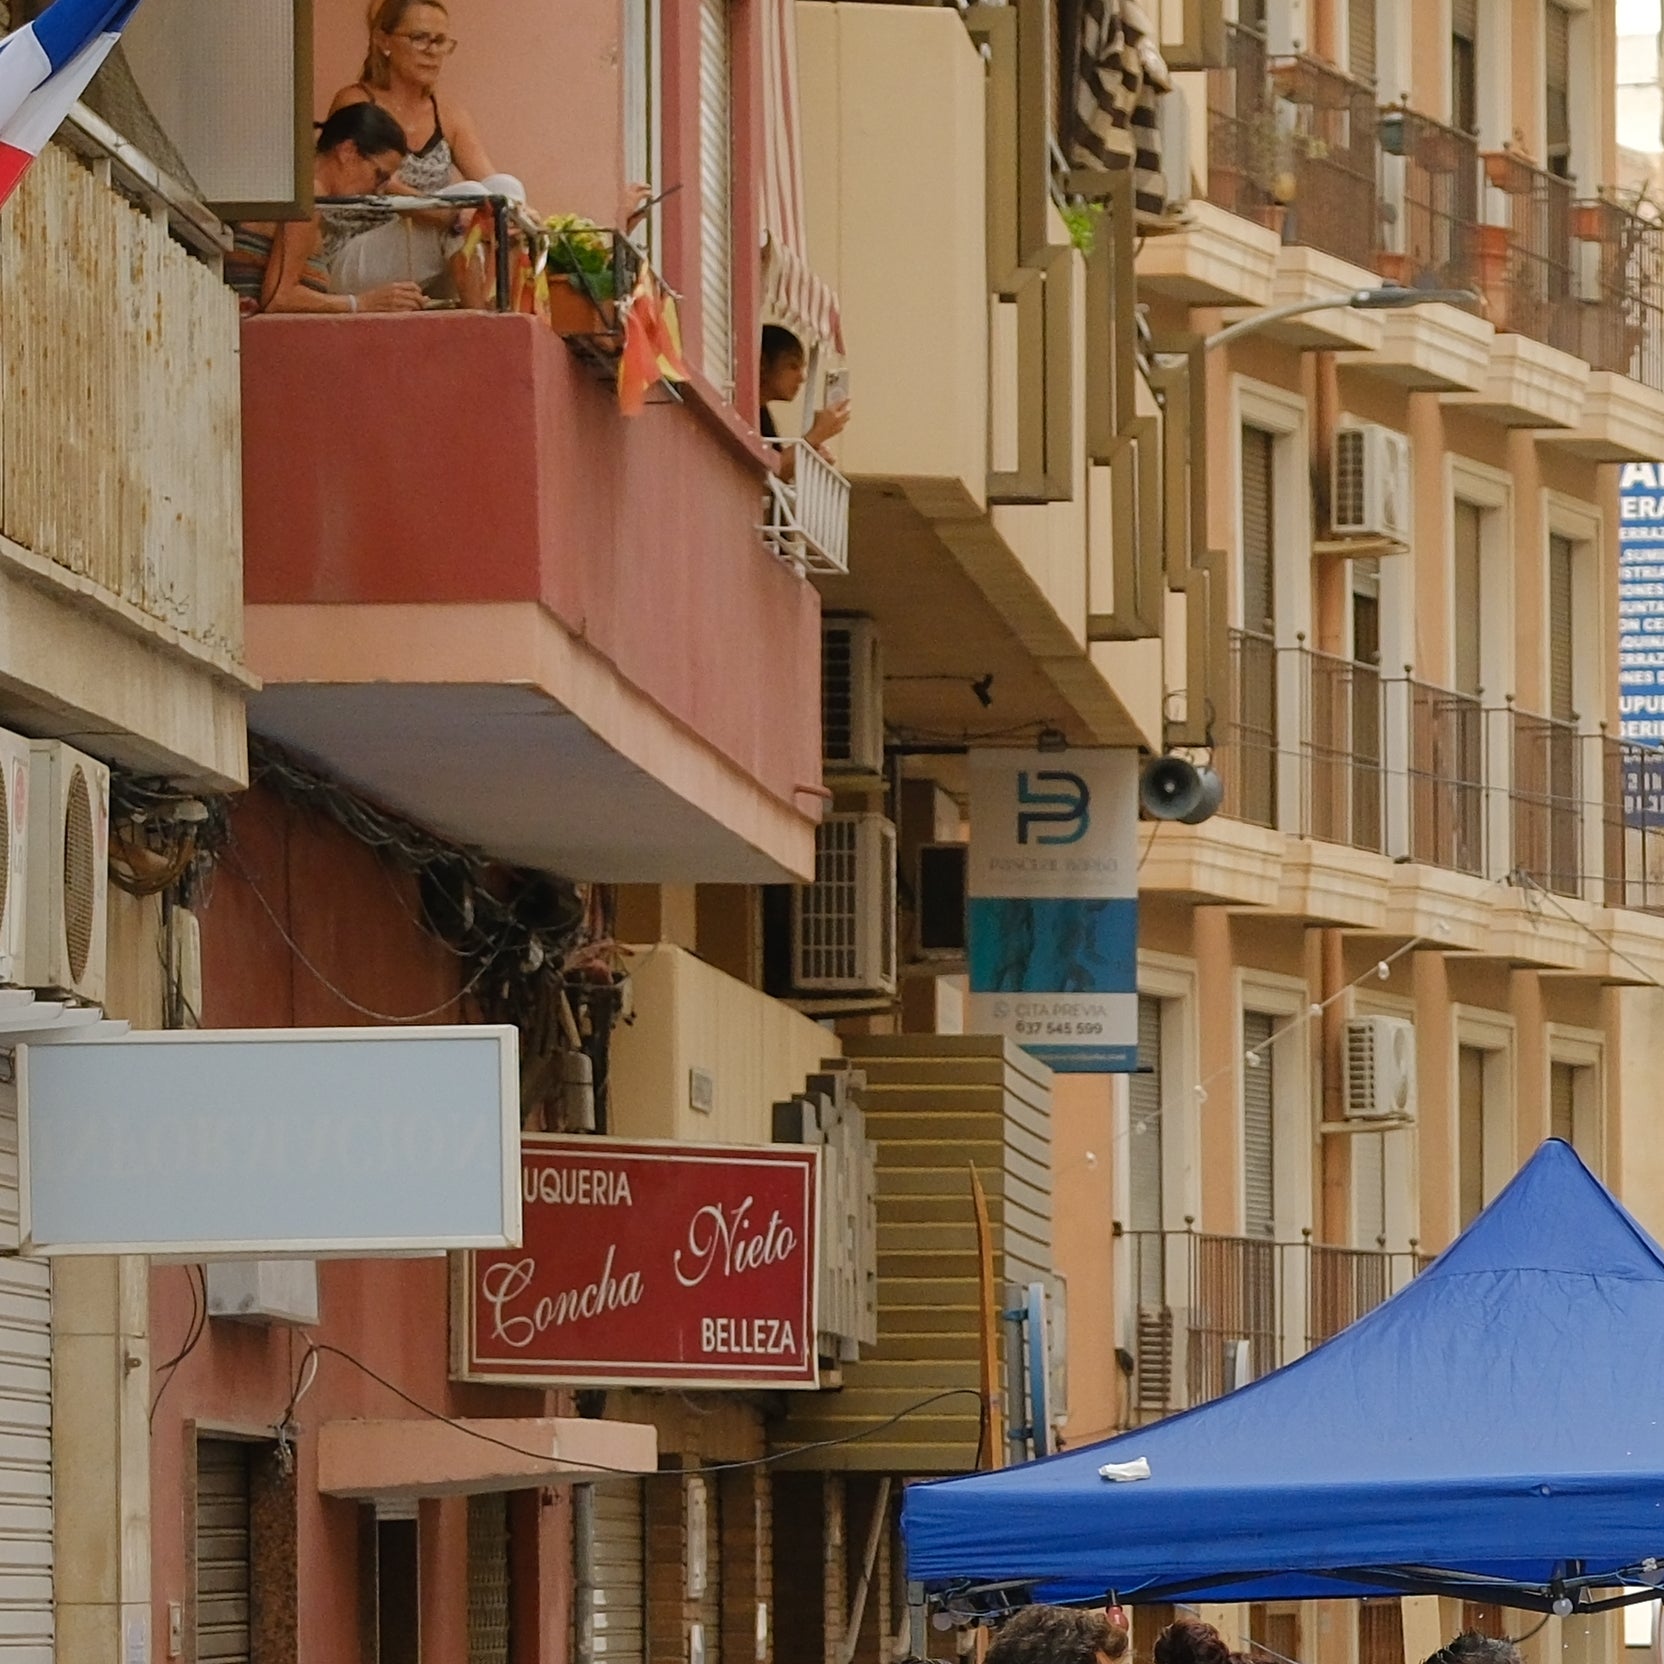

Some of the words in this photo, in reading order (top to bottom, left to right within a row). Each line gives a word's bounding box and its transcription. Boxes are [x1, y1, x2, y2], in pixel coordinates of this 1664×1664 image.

[1015, 1003, 1049, 1016] CITA
[1052, 1002, 1107, 1017] PREVIA
[524, 1167, 632, 1206] UQUERIA
[483, 1244, 644, 1348] Concha
[673, 1196, 797, 1287] Nieto
[702, 1317, 796, 1354] BELLEZA
